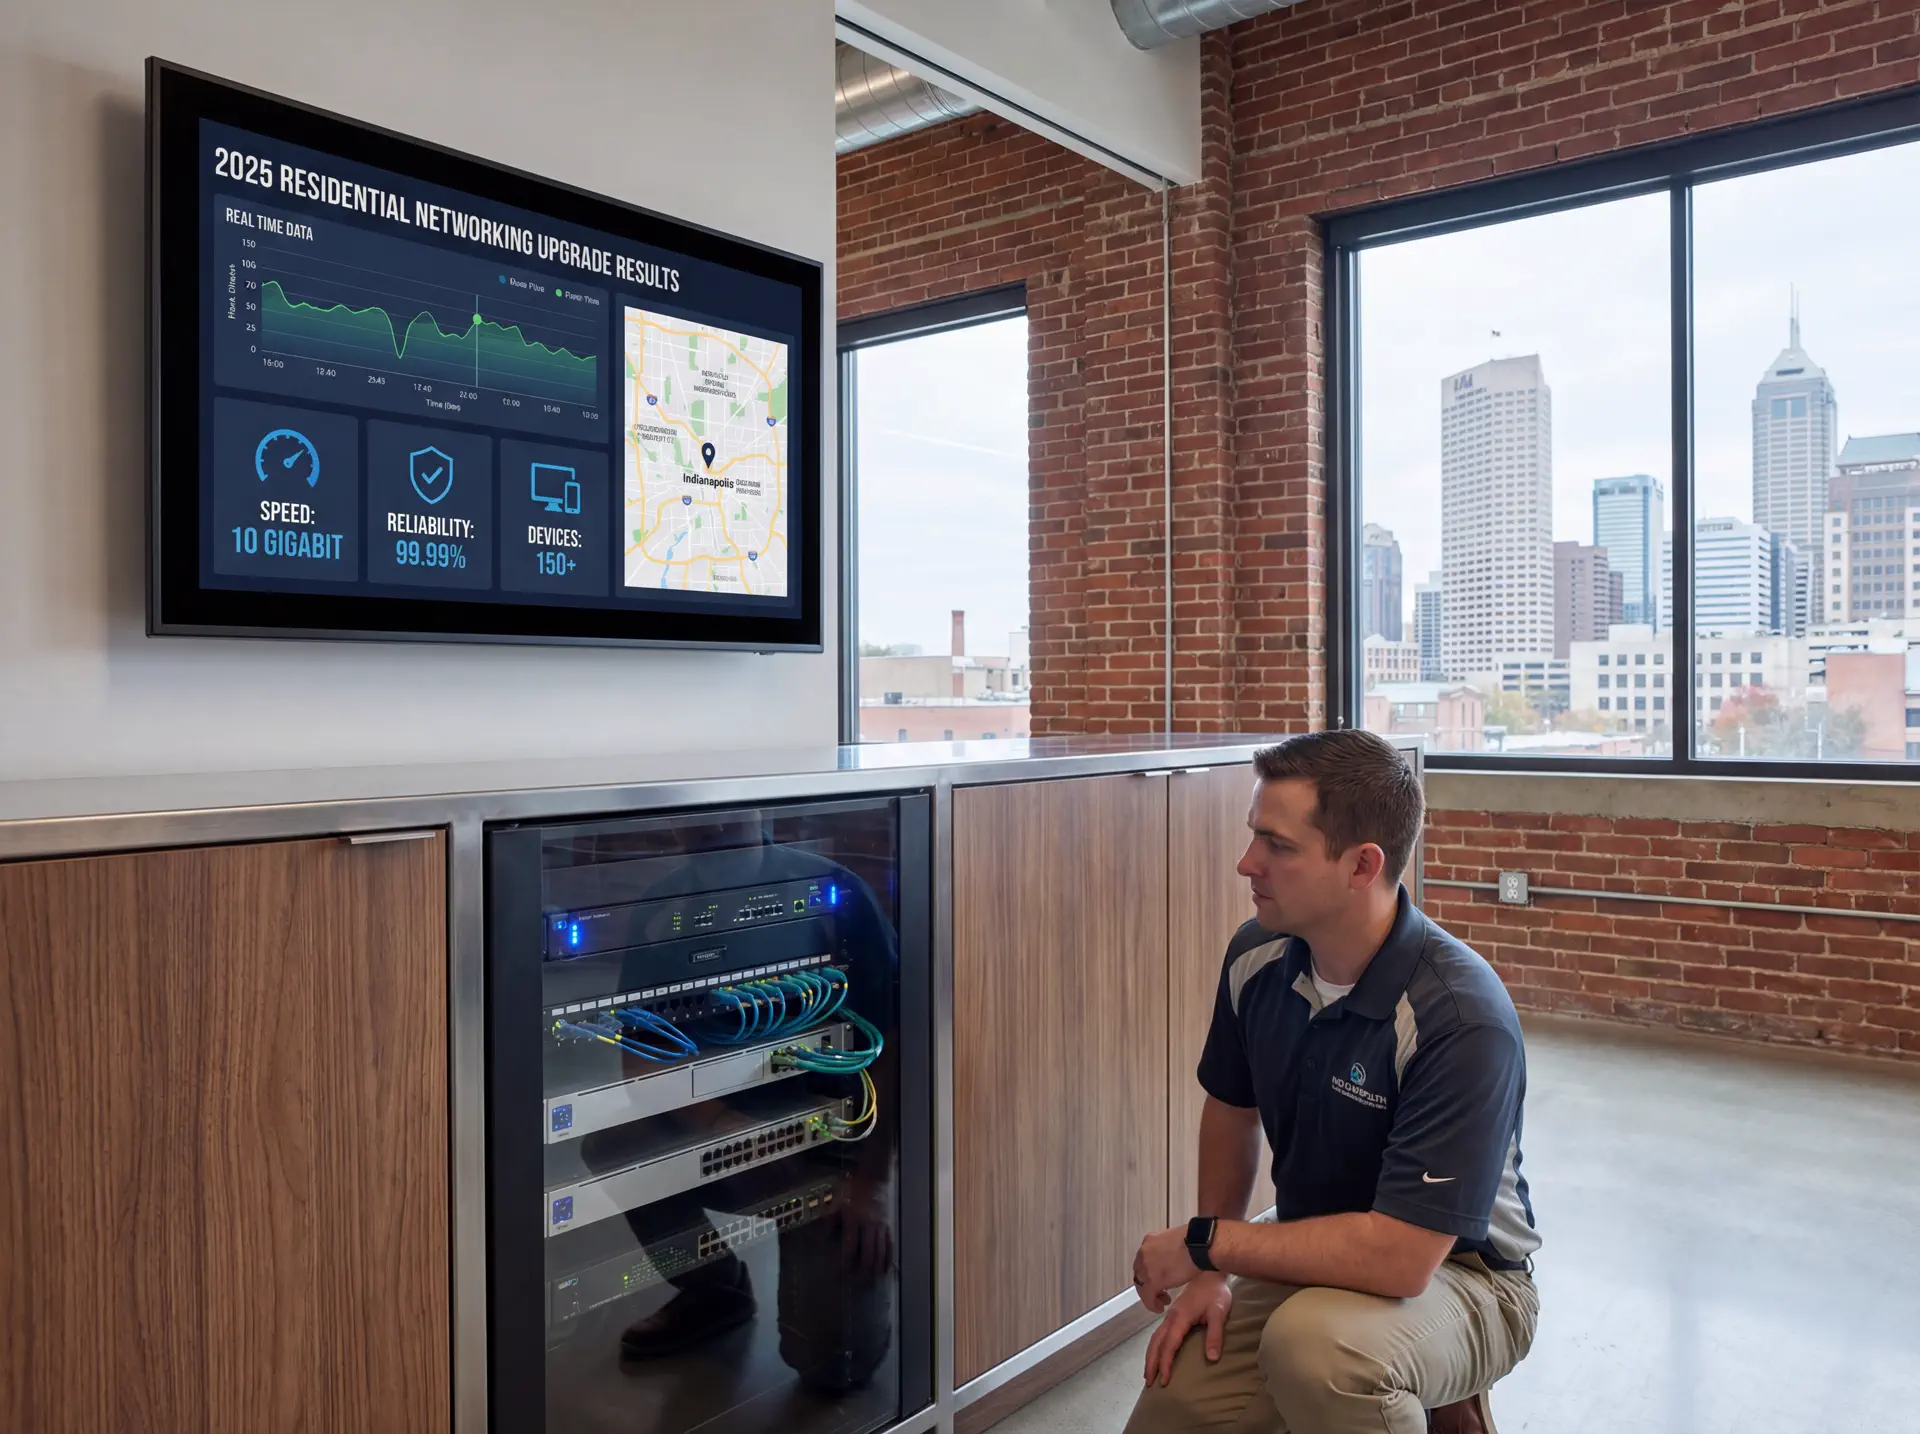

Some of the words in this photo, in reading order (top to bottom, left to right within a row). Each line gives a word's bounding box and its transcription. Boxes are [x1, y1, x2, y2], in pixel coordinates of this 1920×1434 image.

[215, 147, 273, 188] 2025
[280, 164, 410, 224] RESIDENTIAL
[415, 201, 533, 255] NETWORKING
[538, 234, 612, 275] UPGRADE
[616, 254, 680, 293] RESULTS
[226, 207, 255, 228] REAL
[257, 214, 284, 235] TIME
[286, 222, 314, 241] DATA
[242, 238, 256, 248] 150
[245, 280, 257, 290] 70
[246, 323, 256, 332] 25
[260, 500, 316, 525] SPEED:
[387, 512, 475, 539] RELIABILITY:
[528, 525, 582, 548] DEVICES:
[231, 527, 258, 554] 10
[264, 528, 343, 560] GIGABIT
[395, 539, 466, 569] 99.99%
[536, 551, 577, 576] 150+
